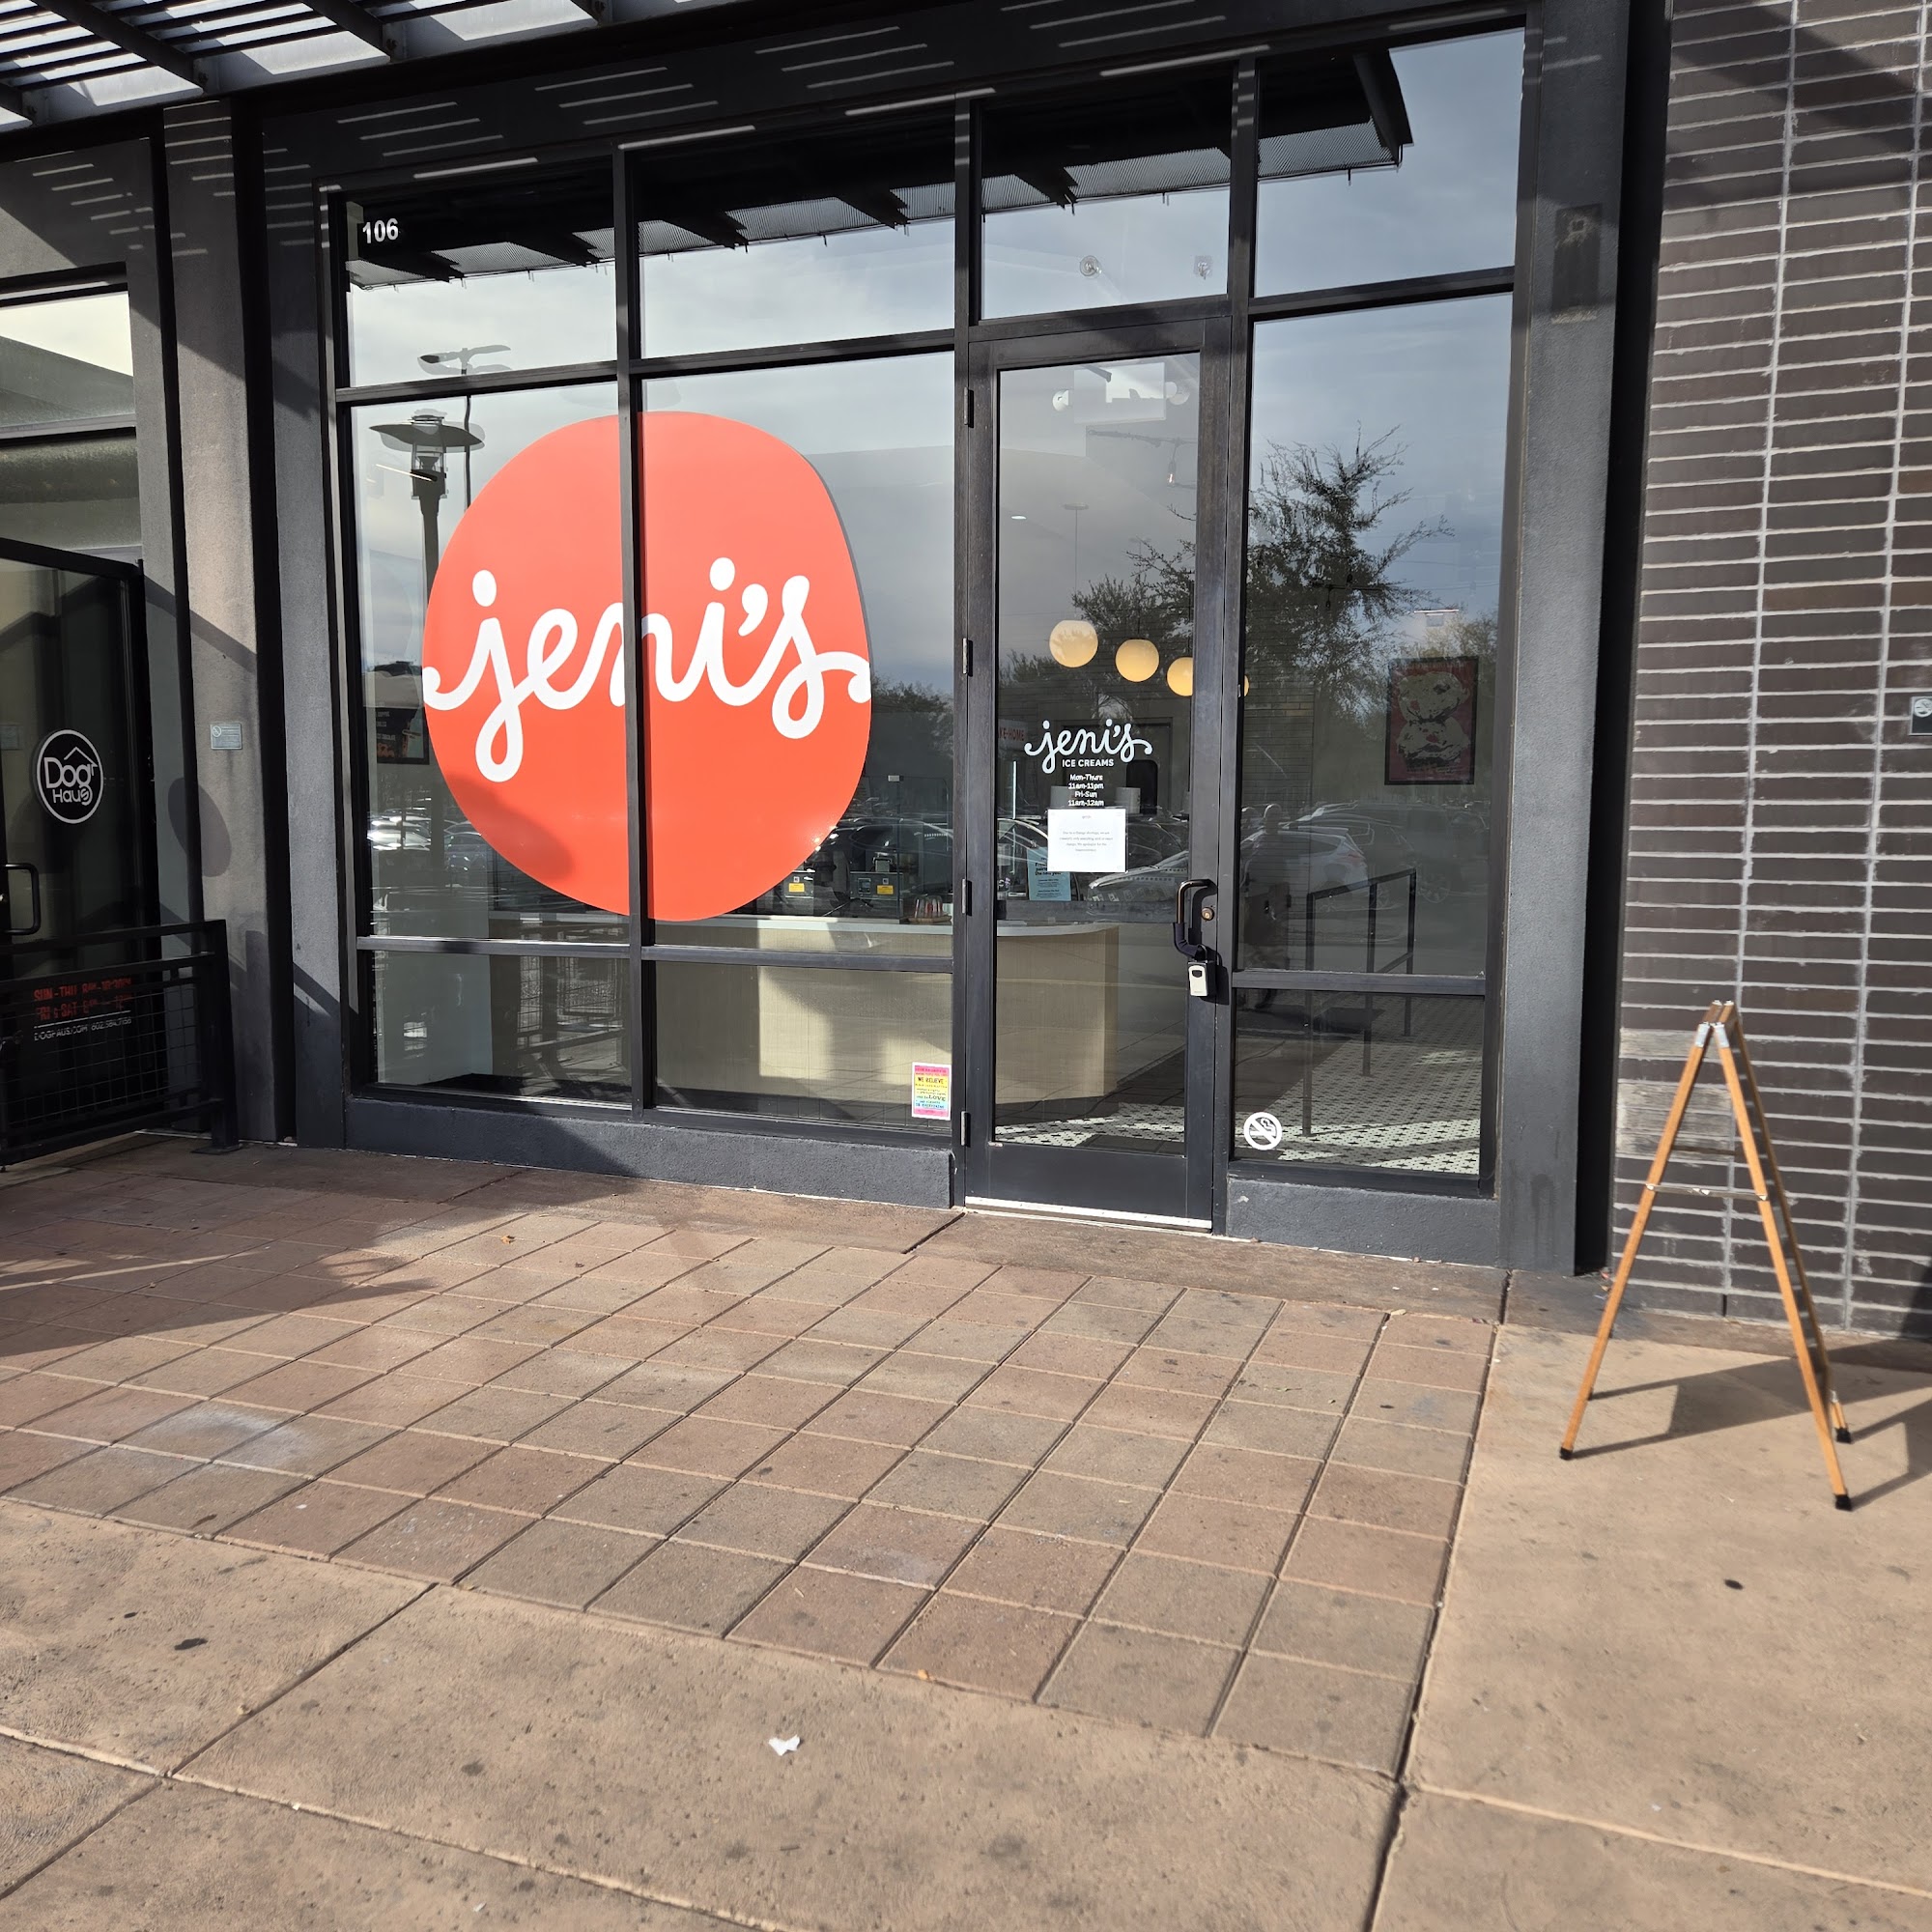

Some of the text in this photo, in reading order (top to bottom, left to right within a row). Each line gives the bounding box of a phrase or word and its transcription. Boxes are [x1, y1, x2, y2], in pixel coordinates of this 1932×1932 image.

[362, 217, 399, 244] 106
[422, 556, 871, 782] jeni's
[1024, 718, 1153, 774] jeni's
[43, 755, 94, 791] Dog
[1062, 758, 1115, 768] ICE CREAMS
[52, 788, 91, 804] Haus
